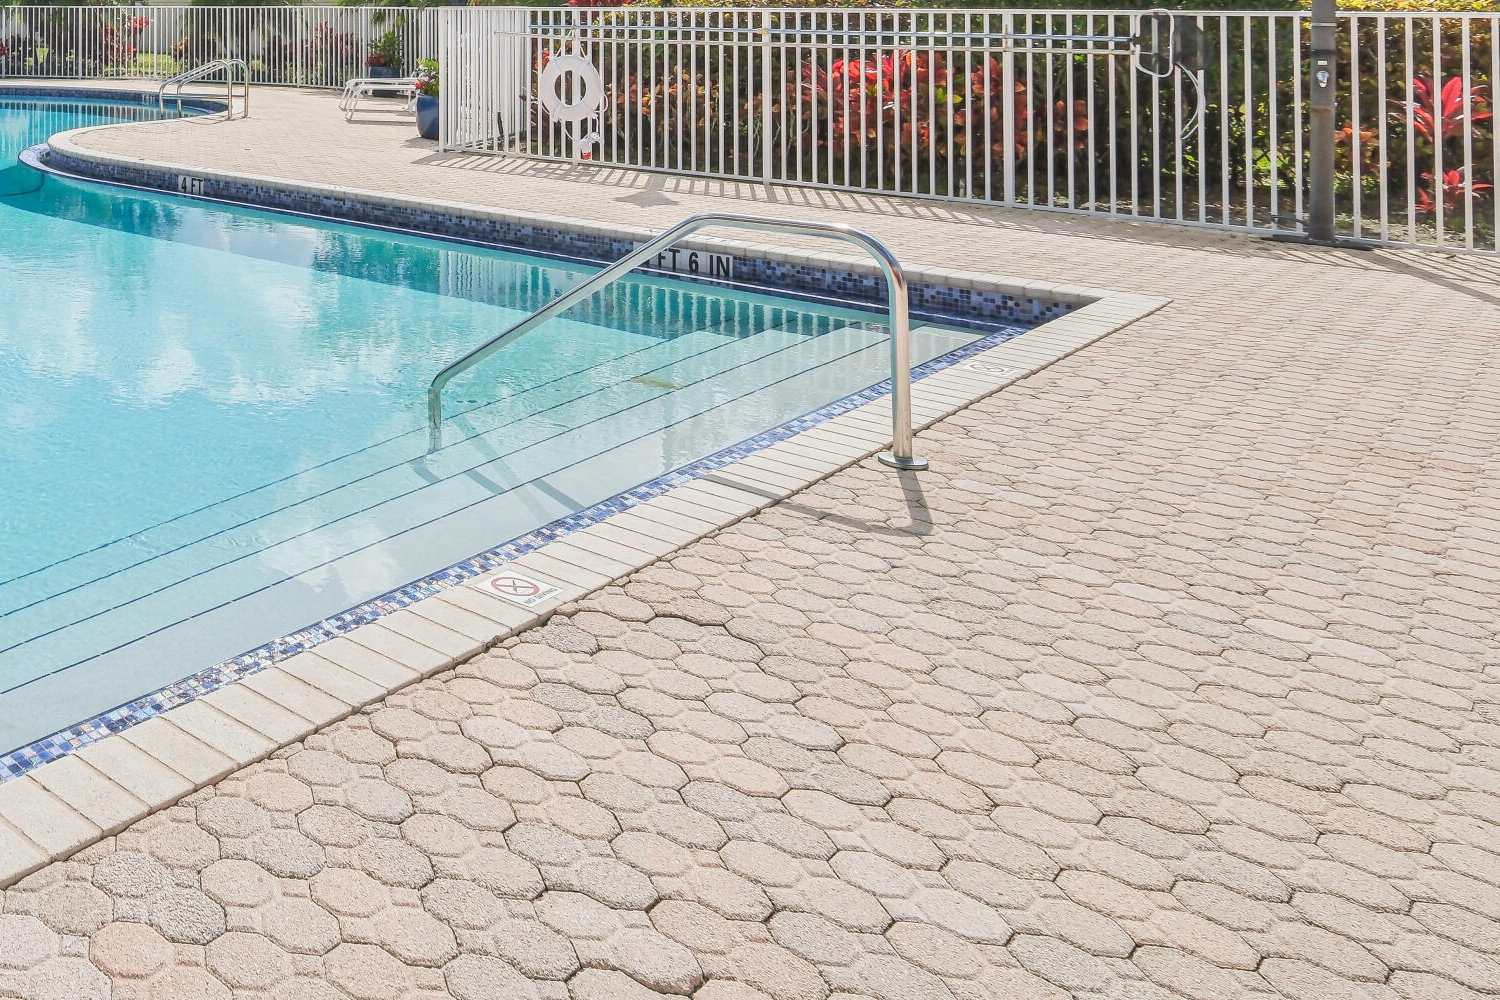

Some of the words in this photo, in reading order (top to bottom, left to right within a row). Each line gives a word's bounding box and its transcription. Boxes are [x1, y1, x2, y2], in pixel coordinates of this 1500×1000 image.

[181, 177, 187, 193] 4
[191, 178, 203, 195] FT
[689, 252, 699, 273] 6
[709, 255, 730, 278] IN
